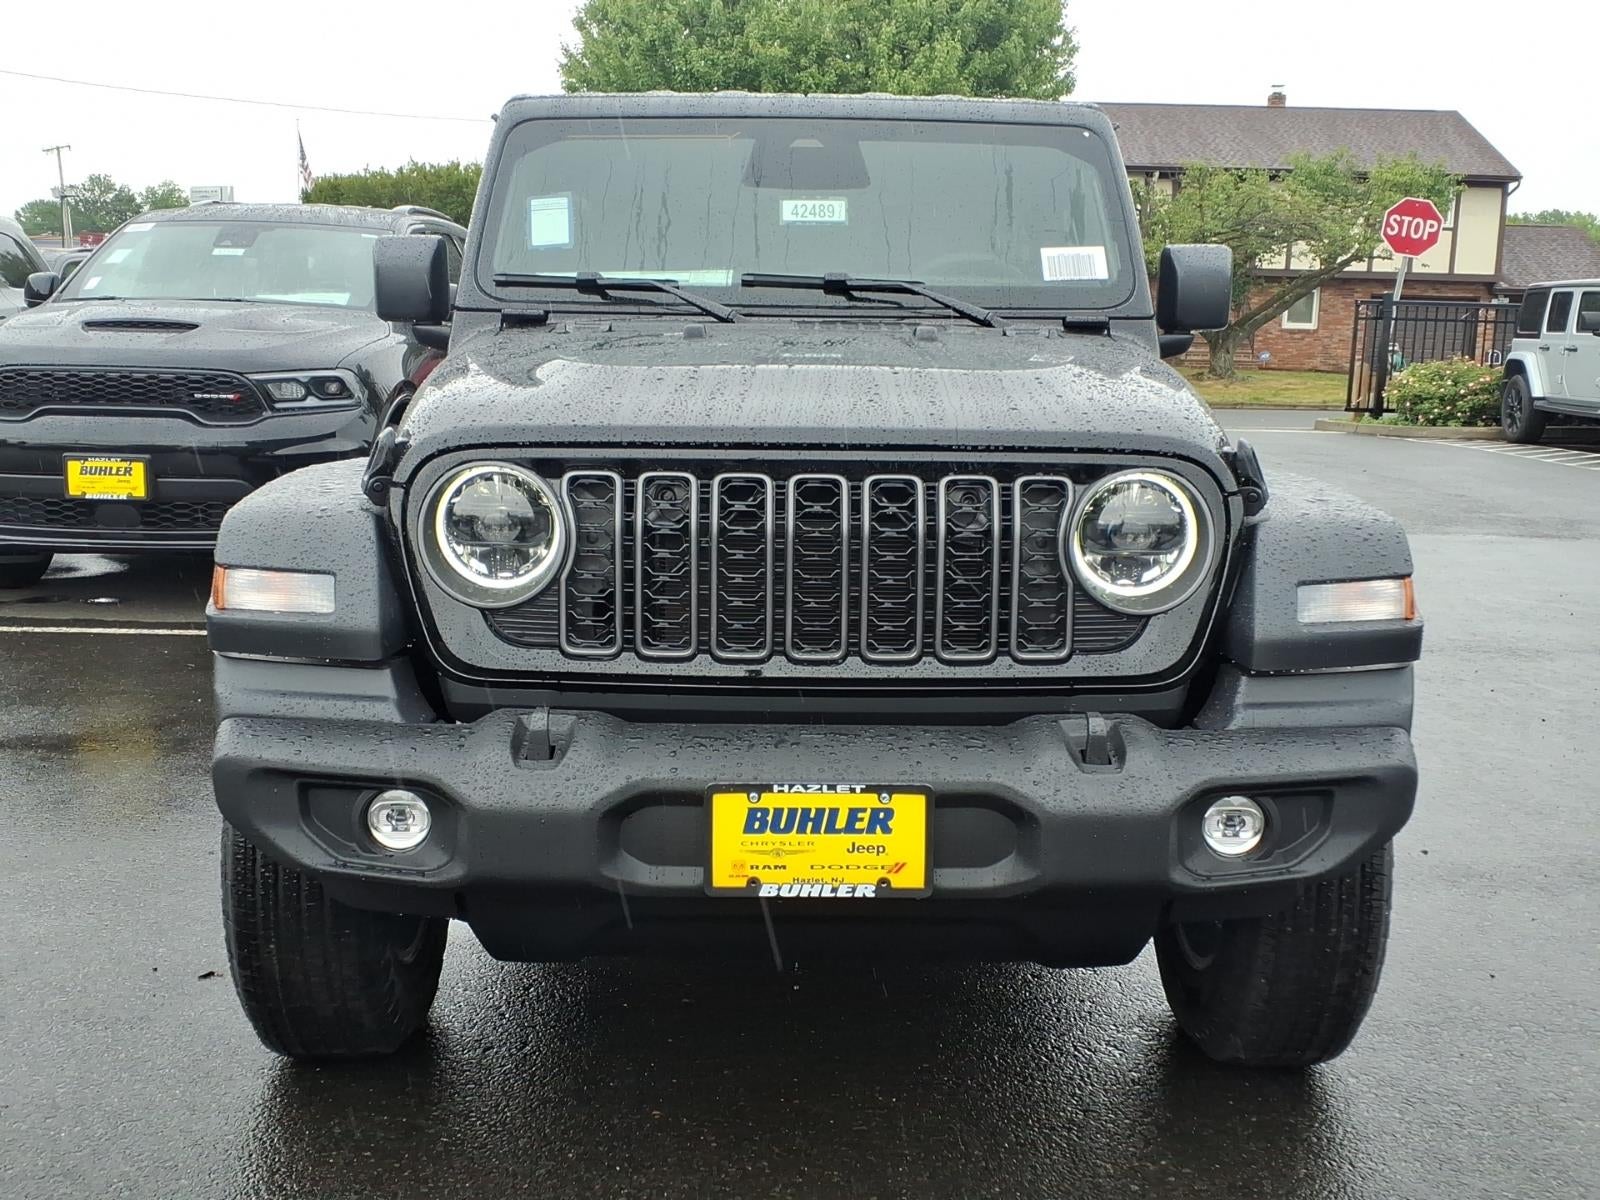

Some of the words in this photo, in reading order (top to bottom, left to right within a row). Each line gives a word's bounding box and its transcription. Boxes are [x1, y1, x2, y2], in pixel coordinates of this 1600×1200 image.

[791, 203, 835, 219] 42489
[1386, 214, 1439, 241] STOP
[79, 465, 133, 477] BUHLER
[772, 784, 867, 794] HAZLET
[742, 807, 895, 835] BUHLER
[846, 842, 886, 856] Jeep
[758, 883, 876, 898] BUHLER
